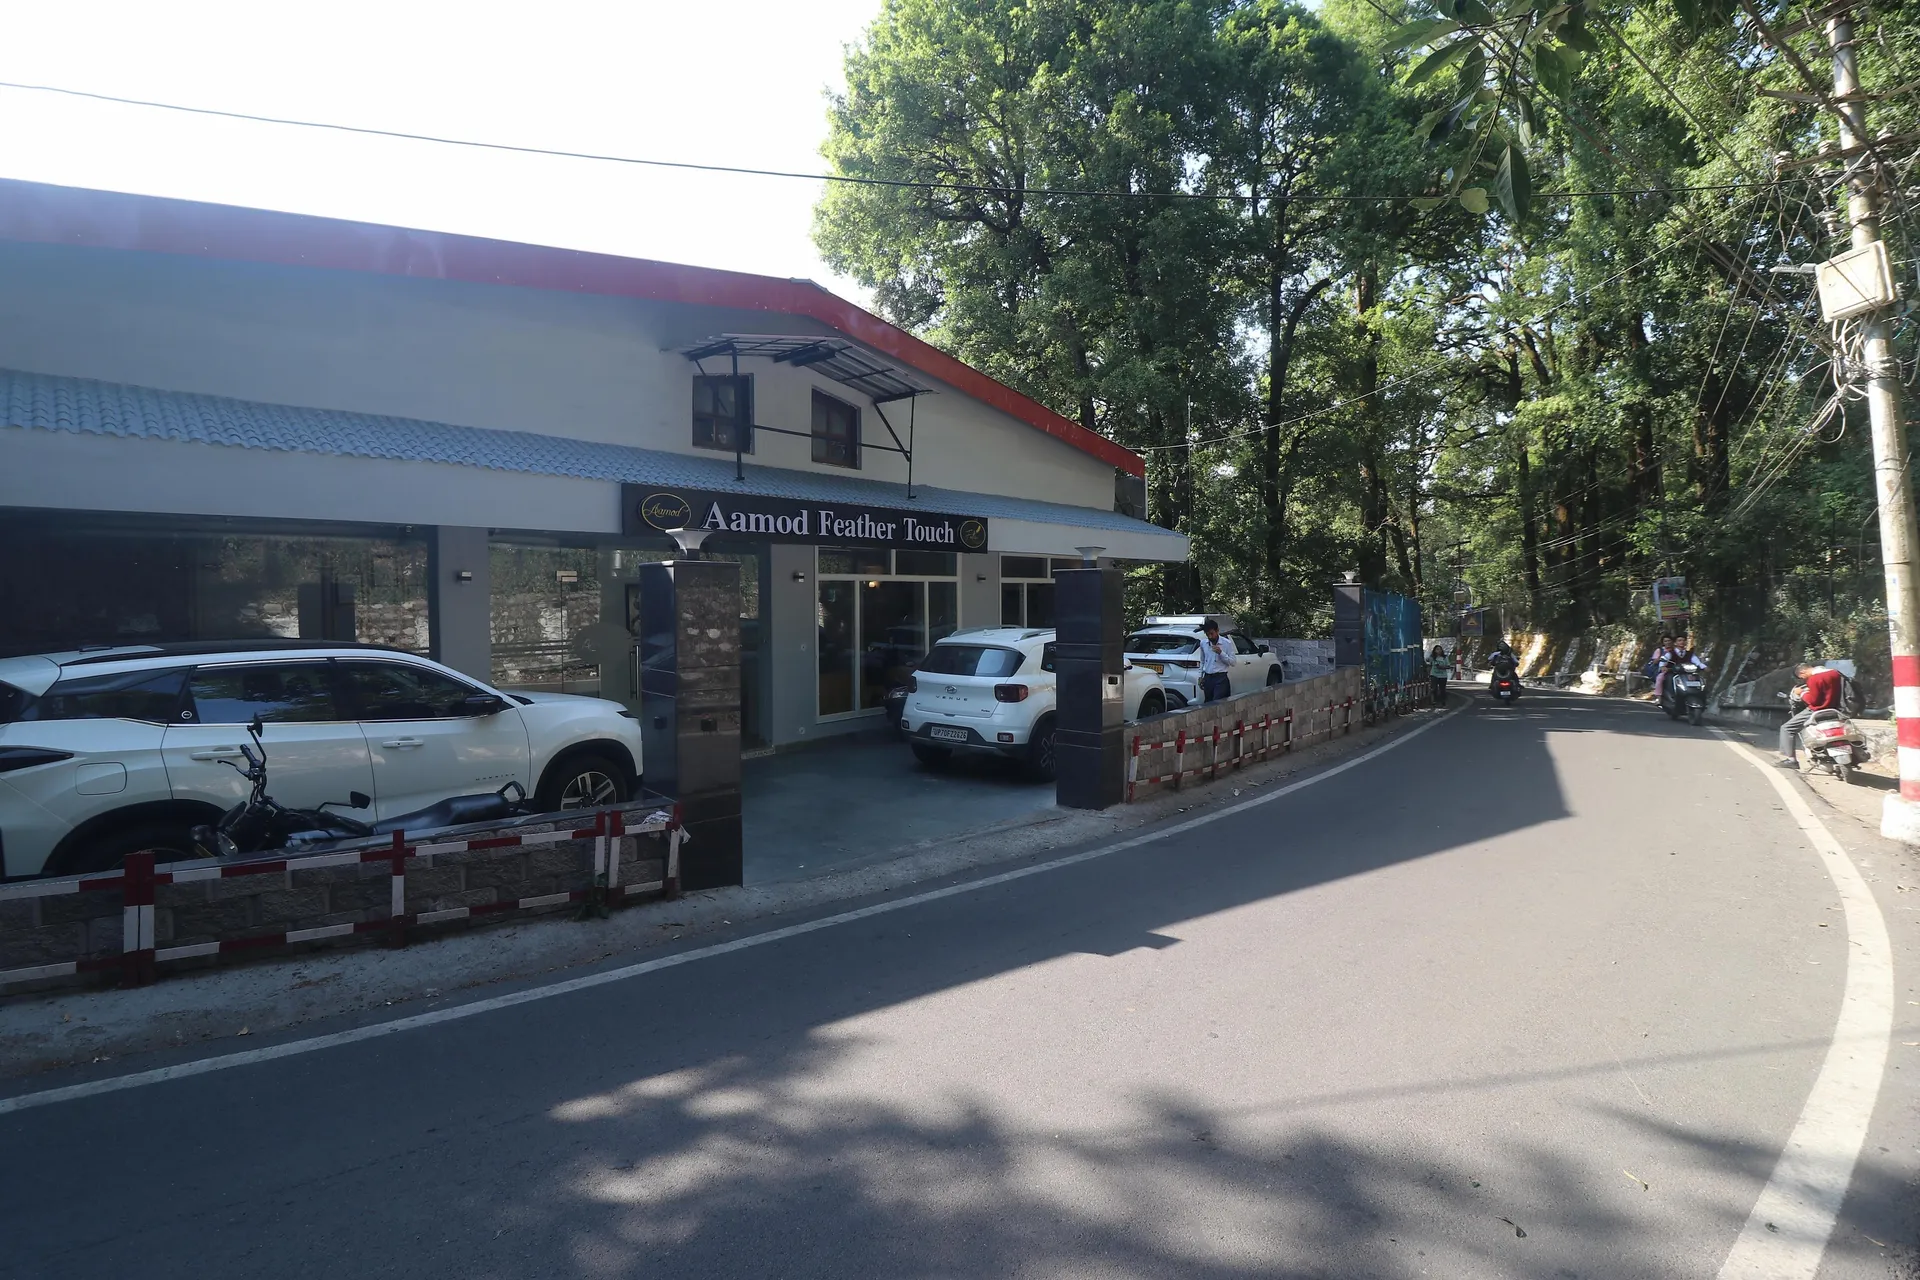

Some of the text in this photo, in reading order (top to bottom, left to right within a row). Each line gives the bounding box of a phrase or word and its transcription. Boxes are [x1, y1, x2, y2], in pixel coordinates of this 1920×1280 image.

[646, 502, 687, 518] Aamod
[702, 501, 810, 535] Aamod
[818, 510, 897, 540] Feather
[903, 517, 955, 543] Touch
